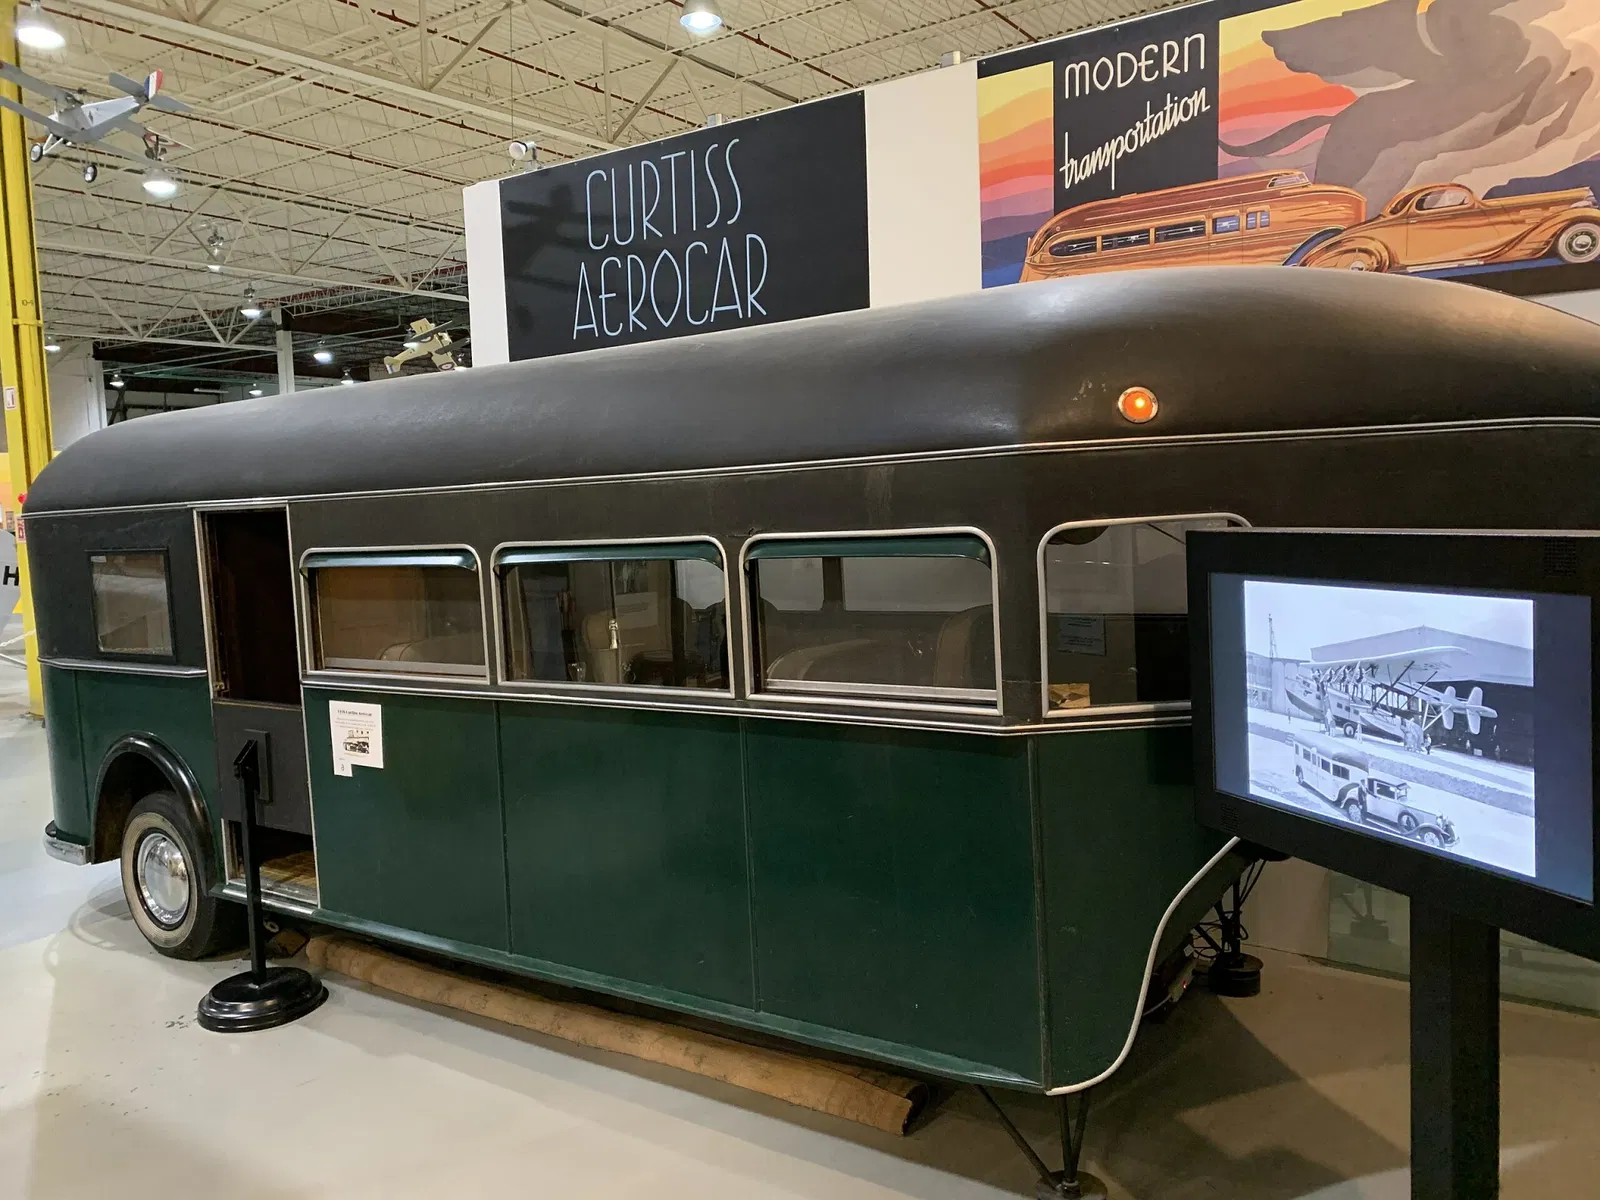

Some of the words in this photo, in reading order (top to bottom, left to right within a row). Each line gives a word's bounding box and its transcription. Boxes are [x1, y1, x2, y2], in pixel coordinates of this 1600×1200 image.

[1065, 33, 1205, 99] MODERN
[1059, 87, 1211, 191] transportation
[586, 138, 742, 250] CURTISS
[572, 233, 768, 340] AEROCAR
[3, 565, 20, 586] H
